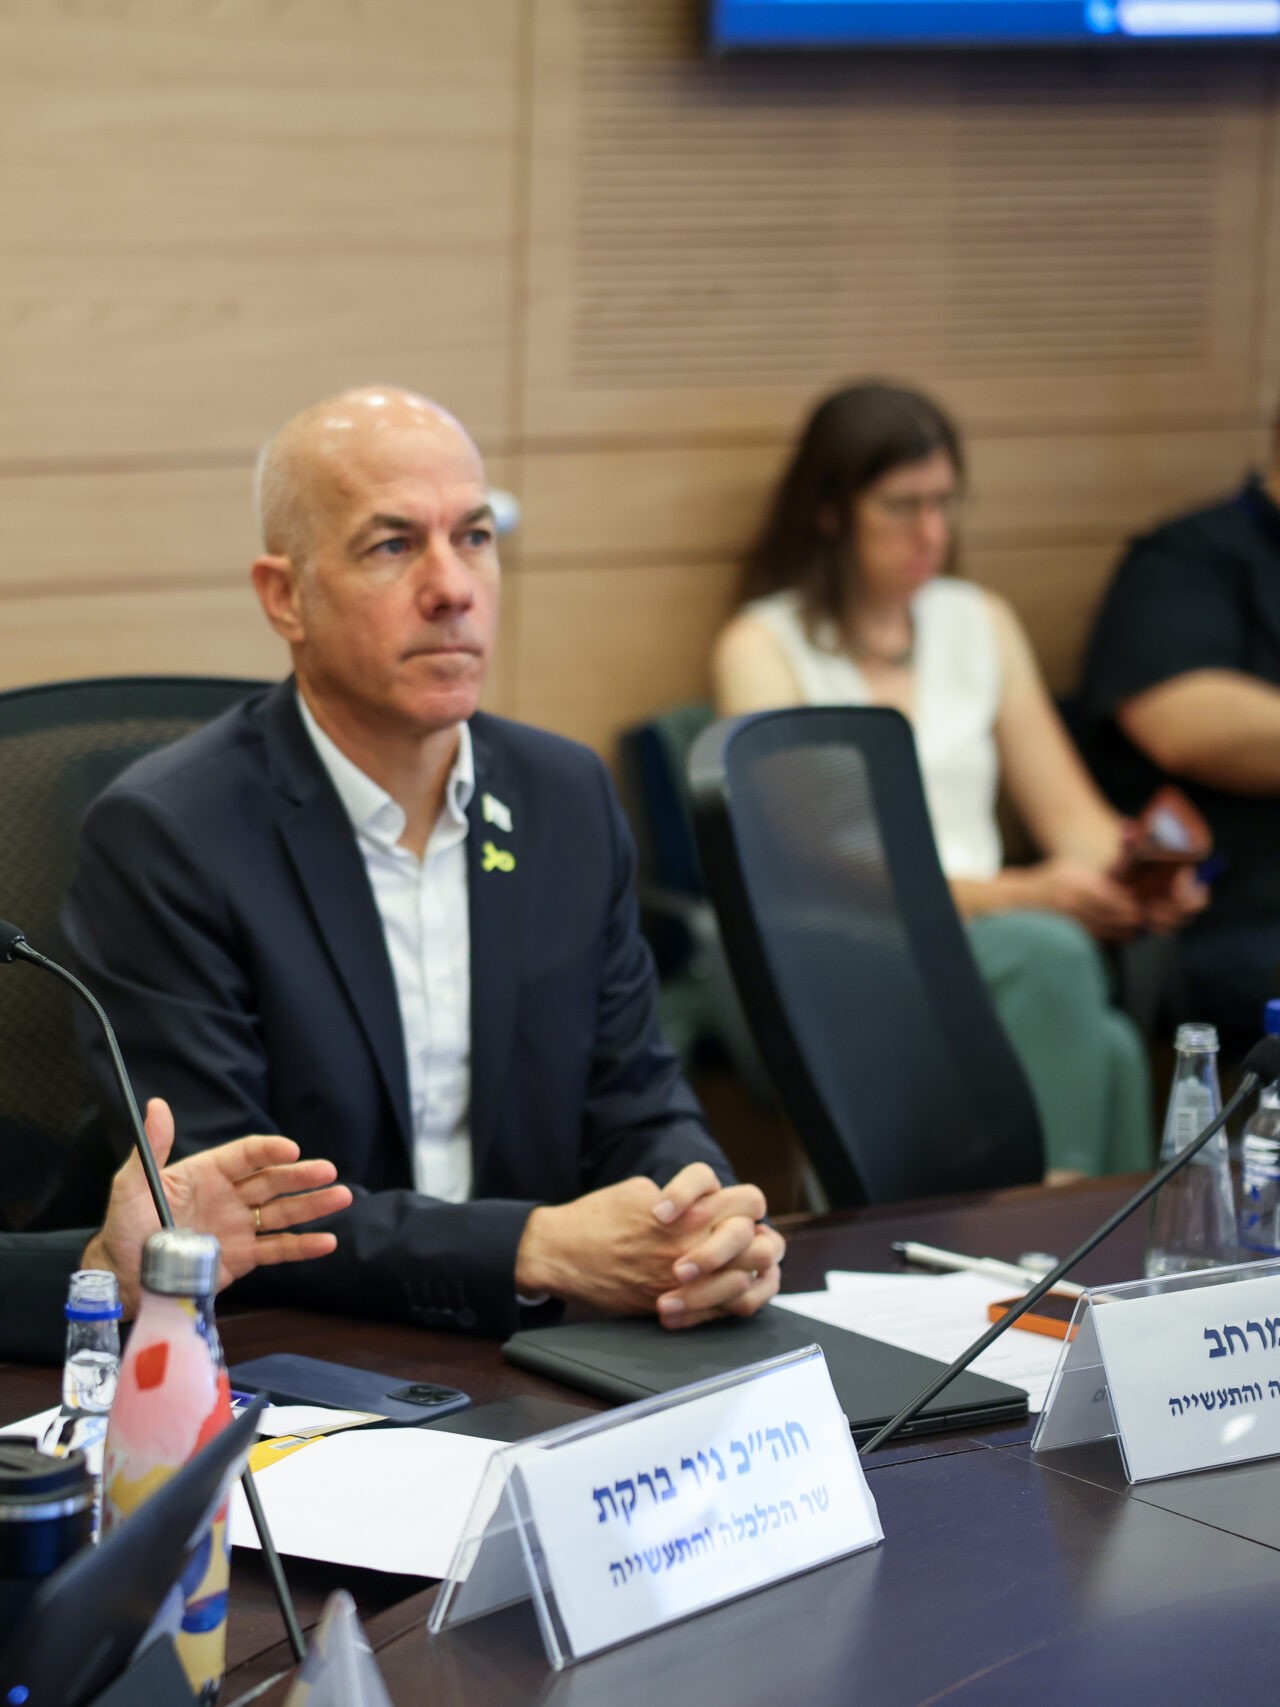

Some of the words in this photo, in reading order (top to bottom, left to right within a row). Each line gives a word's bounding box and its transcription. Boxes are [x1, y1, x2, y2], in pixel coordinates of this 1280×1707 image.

[1169, 1382, 1263, 1416] והתעשייה
[681, 1447, 727, 1488] ניר
[593, 1466, 677, 1525] ברקת
[800, 1485, 829, 1515] שר
[718, 1500, 797, 1546] הכלכלה
[609, 1526, 715, 1587] והתעשייה
